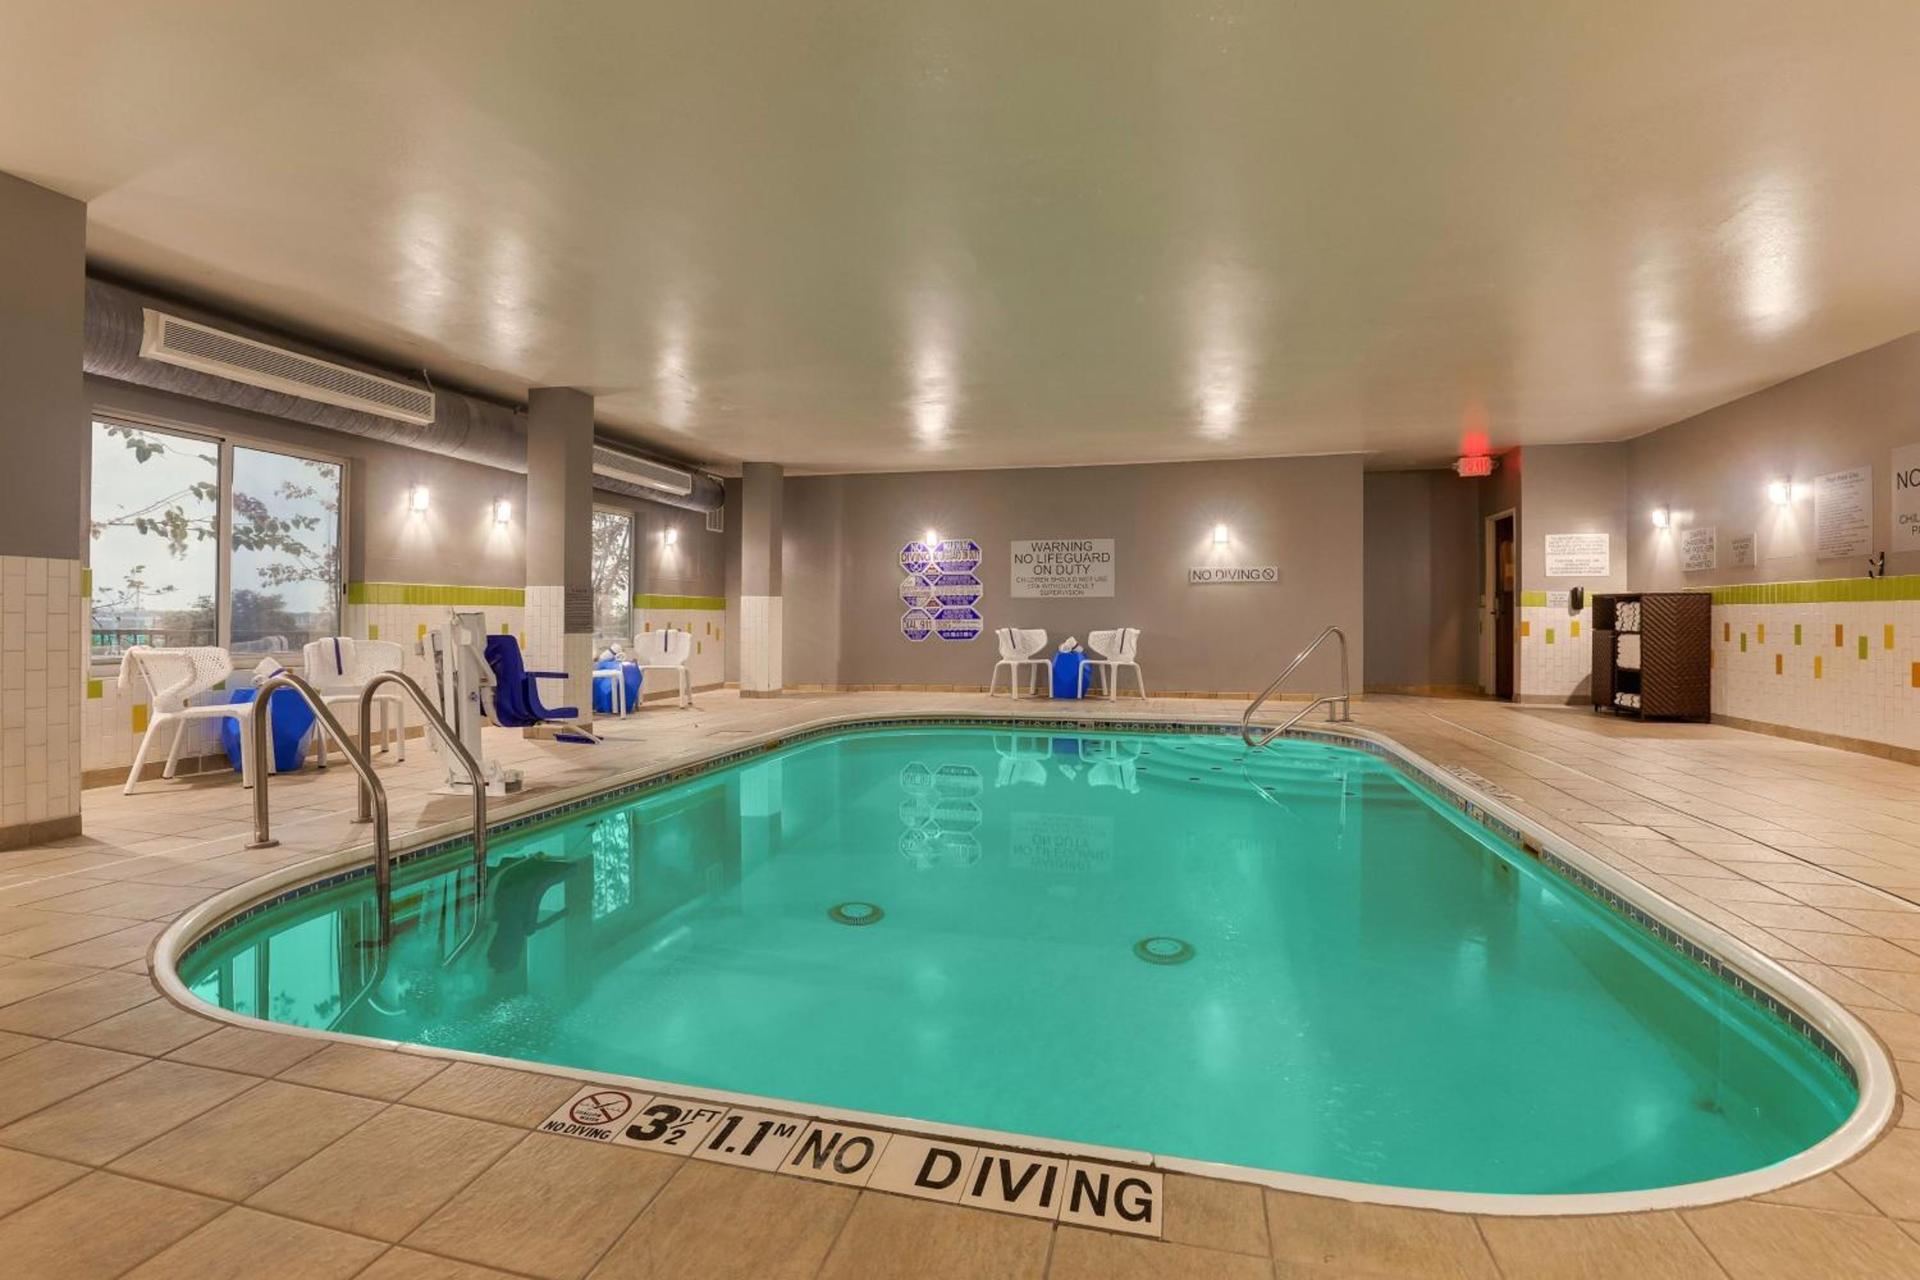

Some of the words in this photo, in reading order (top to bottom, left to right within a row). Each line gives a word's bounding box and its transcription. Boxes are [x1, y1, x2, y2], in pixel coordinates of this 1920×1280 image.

[1030, 541, 1093, 552] WARNING
[1014, 553, 1034, 564] NO
[1036, 552, 1111, 564] LIFEGUARD
[1033, 565, 1052, 575] ON
[1056, 564, 1091, 575] DUTY
[1192, 569, 1212, 580] NO
[1215, 568, 1261, 580] DIVING
[543, 1120, 567, 1134] NO
[563, 1122, 612, 1140] DIVING
[791, 1128, 875, 1175] NO
[914, 1147, 1154, 1223] DIVING
